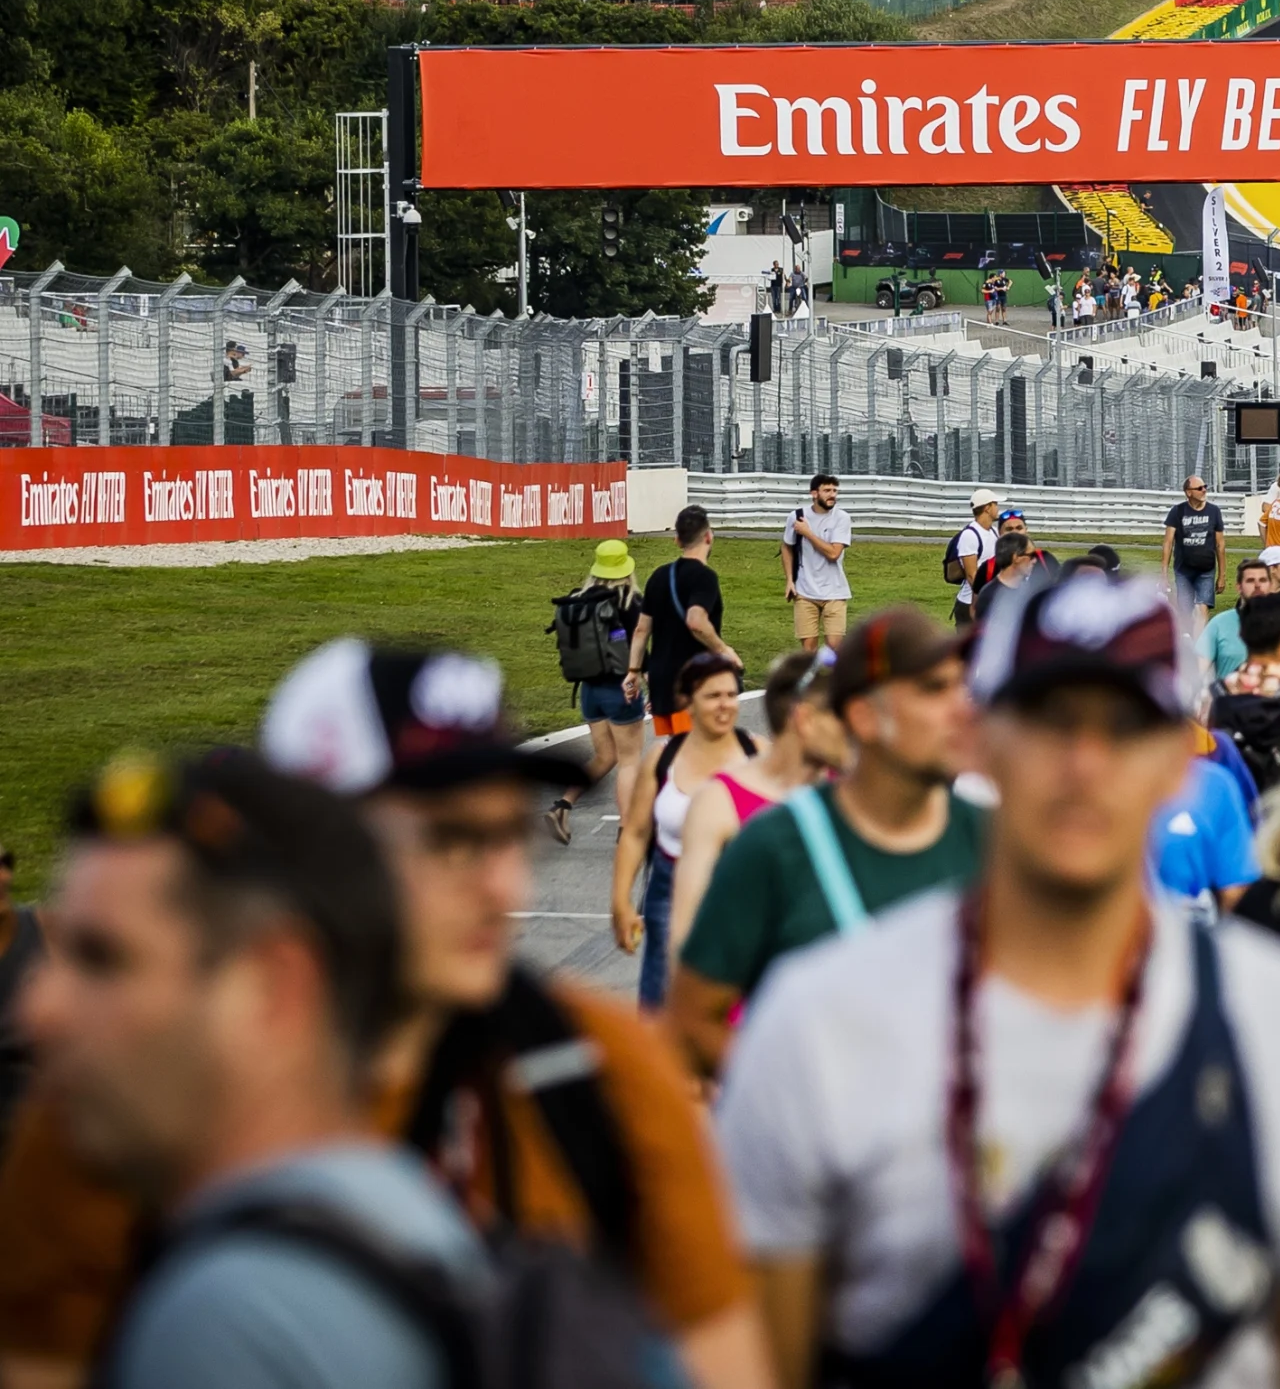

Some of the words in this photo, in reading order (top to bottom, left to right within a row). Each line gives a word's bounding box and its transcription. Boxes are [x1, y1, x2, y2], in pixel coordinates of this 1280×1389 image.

[714, 77, 1081, 156] Emirates
[1117, 78, 1207, 152] FLY
[1211, 196, 1221, 257] SILVER
[1216, 262, 1222, 271] 2
[21, 471, 79, 526] Emirates
[98, 471, 126, 523] BETTER
[144, 469, 194, 522] Emirates
[208, 469, 234, 519] BETTER
[249, 467, 296, 519] Emirates
[344, 467, 385, 517] Emirates
